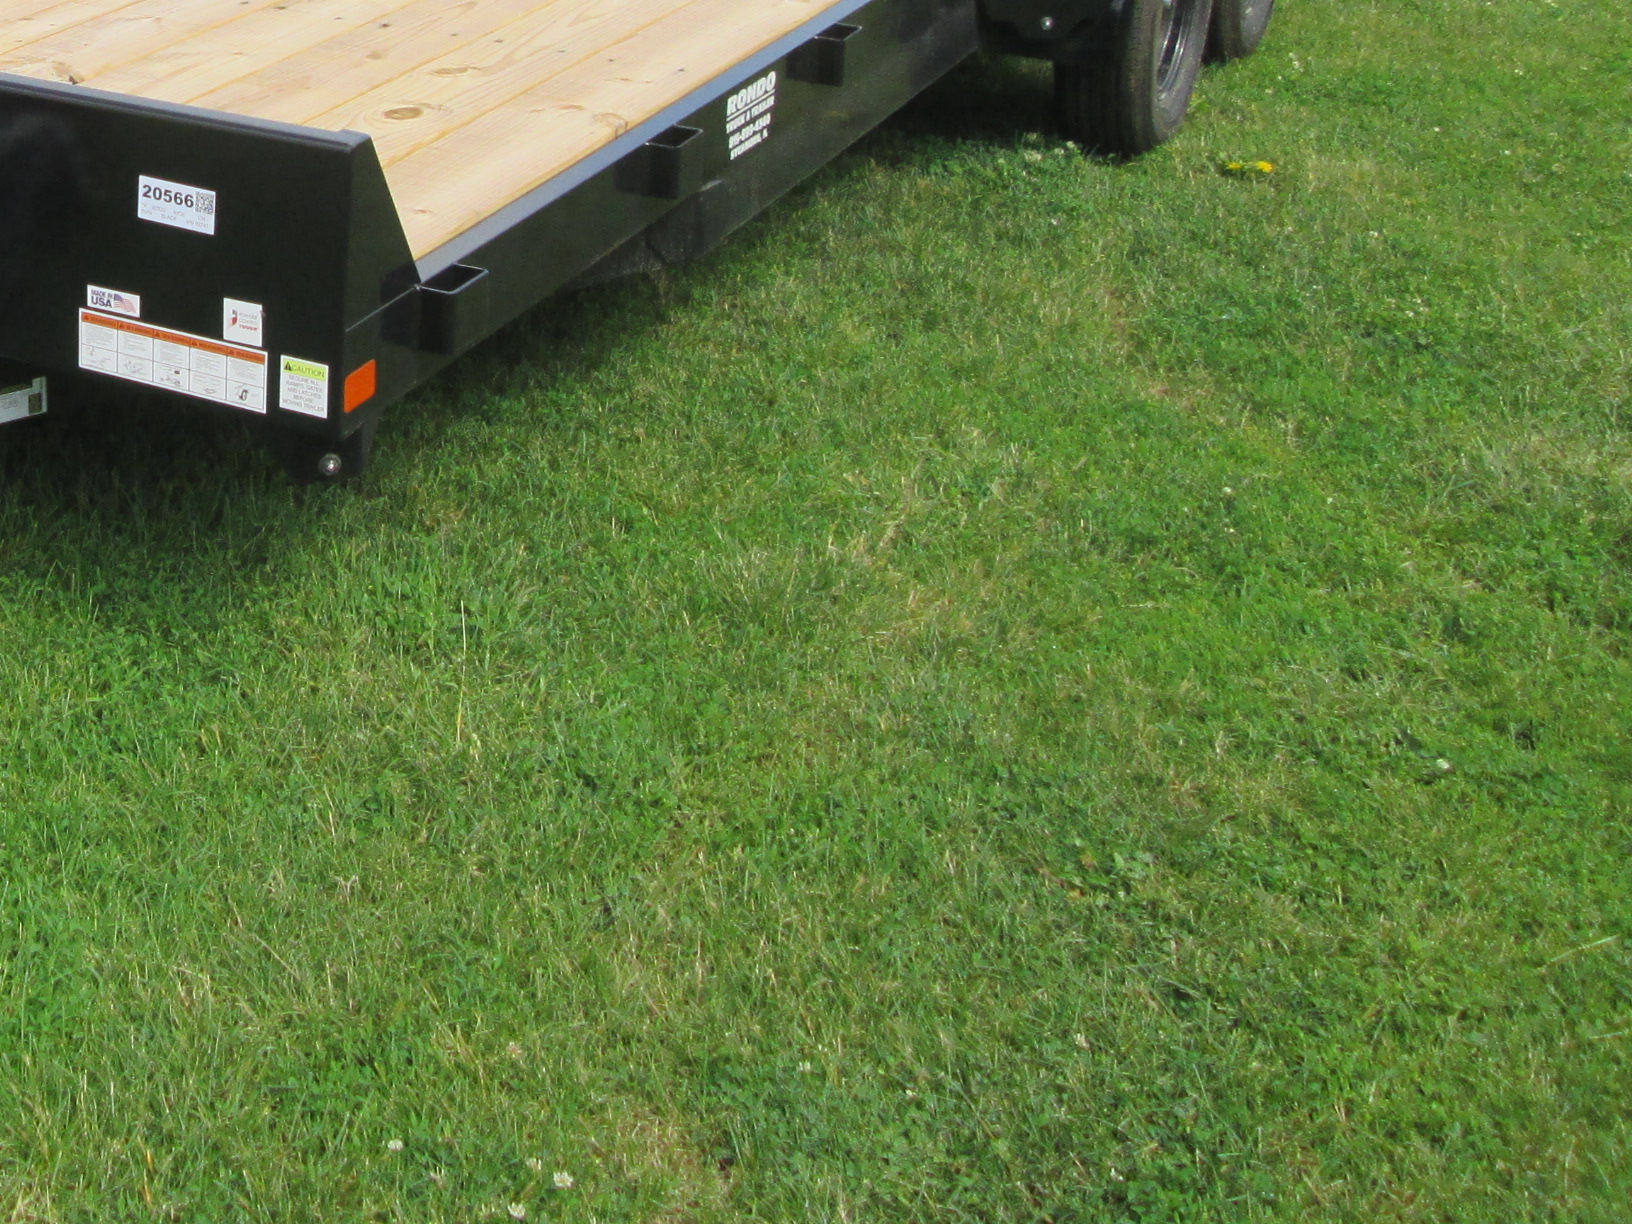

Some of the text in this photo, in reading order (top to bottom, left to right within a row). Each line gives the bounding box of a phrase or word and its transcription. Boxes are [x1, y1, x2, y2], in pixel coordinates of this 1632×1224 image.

[726, 71, 776, 117] RONDO
[142, 184, 194, 208] 20566
[91, 289, 107, 299] MADE
[91, 296, 113, 308] USA
[292, 365, 325, 378] CAUTION
